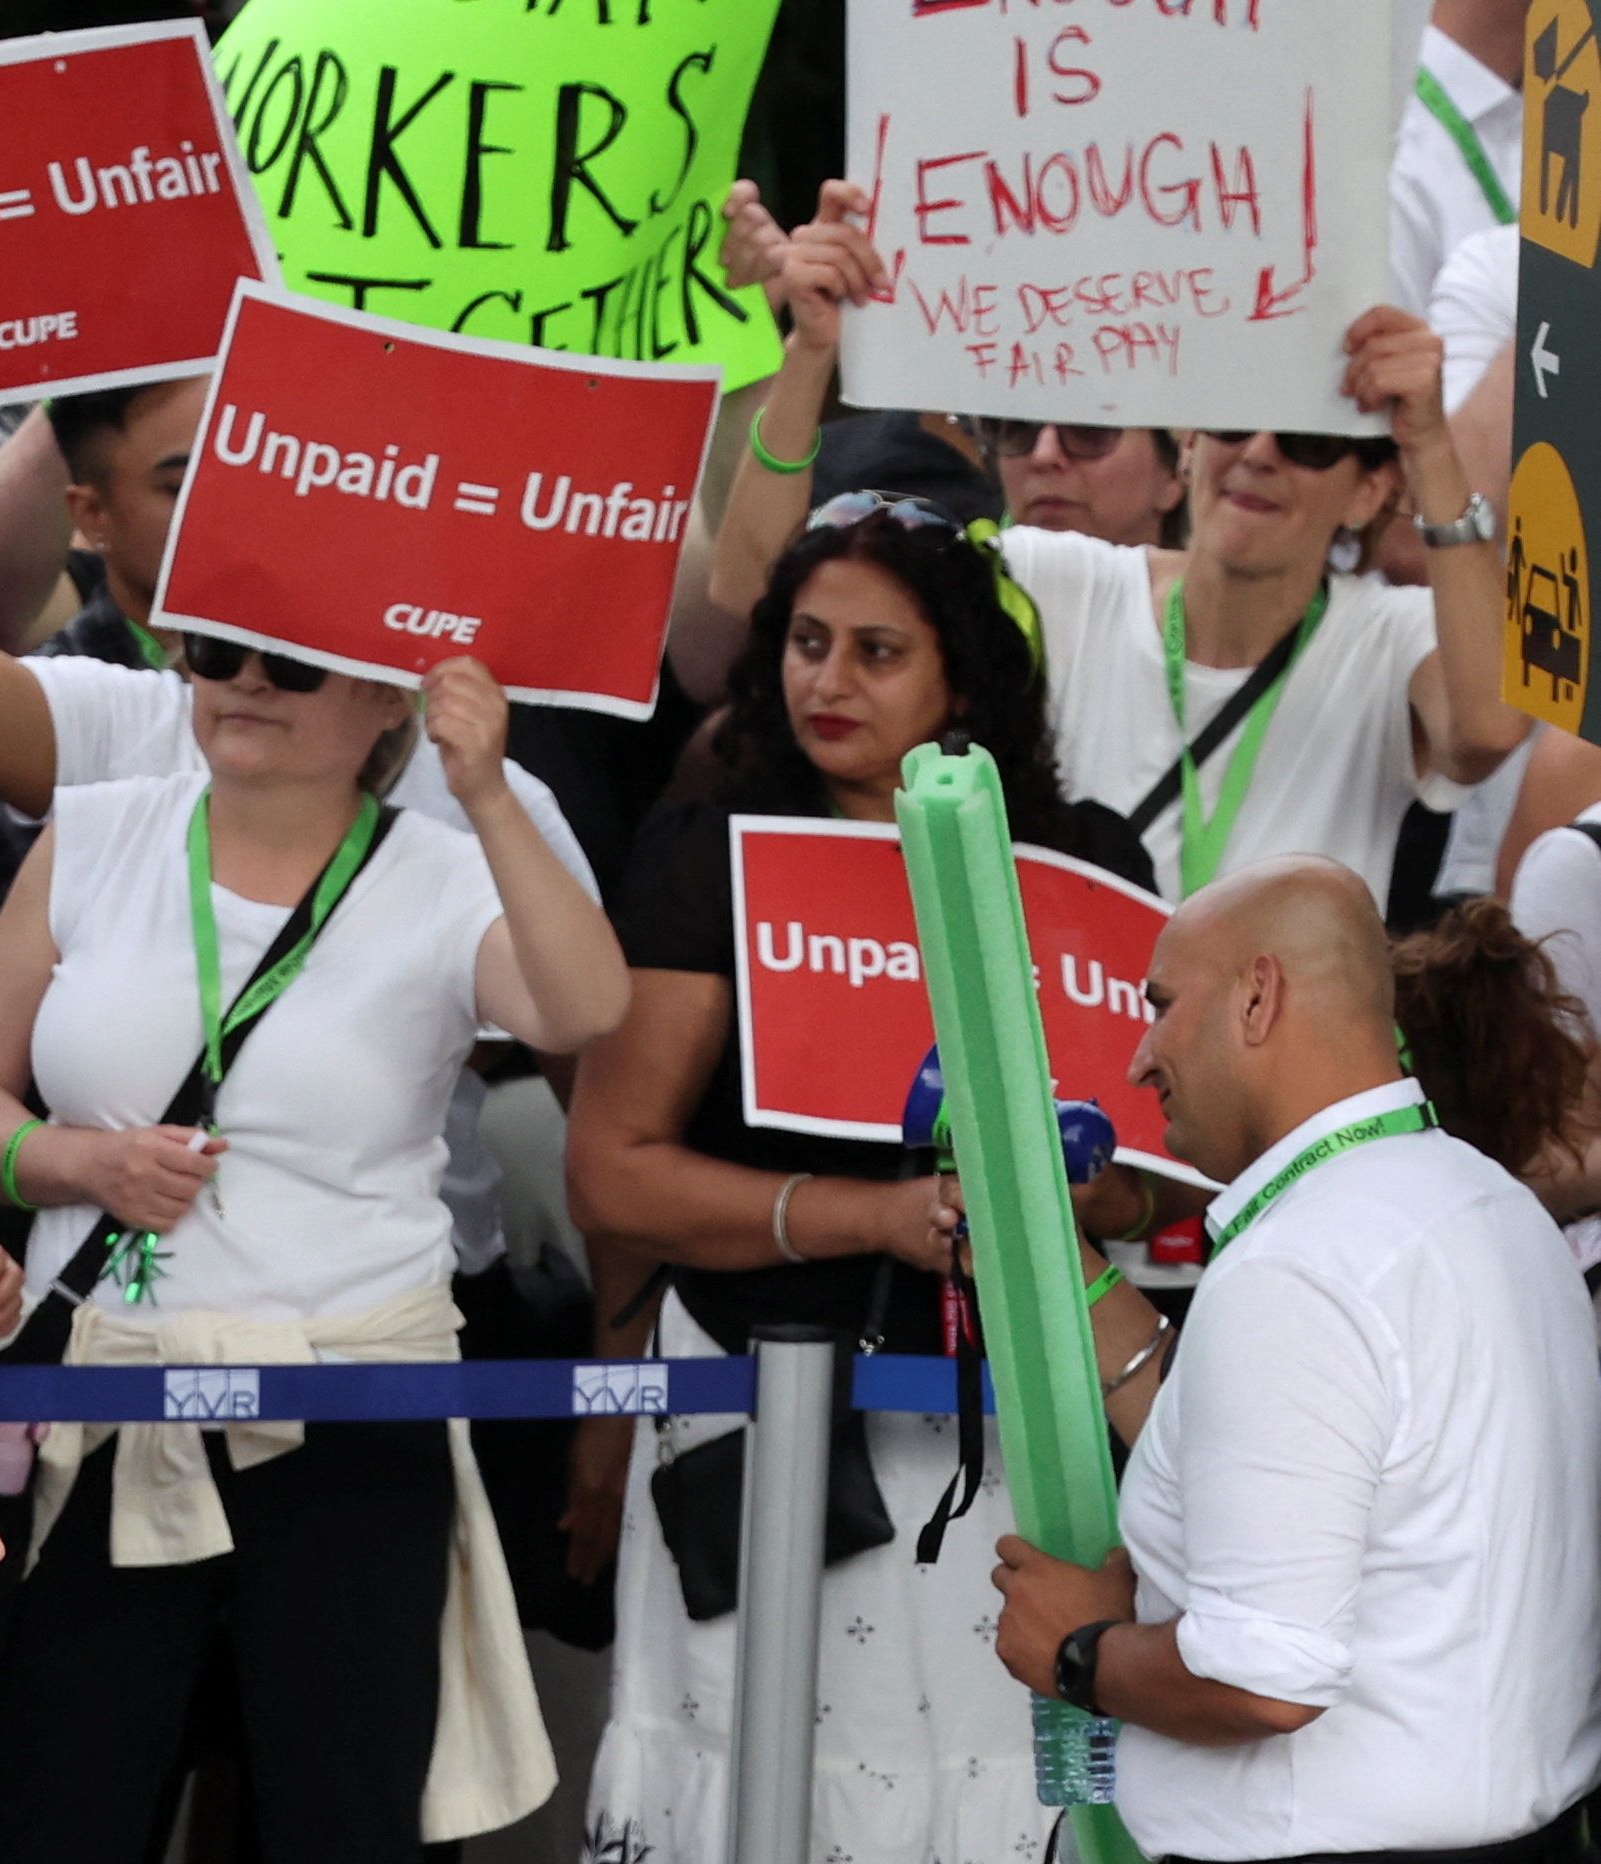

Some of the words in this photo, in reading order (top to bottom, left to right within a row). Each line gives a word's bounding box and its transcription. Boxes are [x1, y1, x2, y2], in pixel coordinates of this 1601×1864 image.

[1011, 24, 1102, 118] IS
[47, 140, 224, 218] Unfair
[913, 132, 1261, 246] ENOUGH
[907, 273, 1001, 337] WE
[1016, 267, 1231, 335] DESERVE
[964, 341, 1086, 389] FAIR
[1091, 321, 1181, 377] PAY
[211, 403, 440, 509] Unpaid
[519, 472, 688, 545] Unfair
[382, 602, 483, 646] CUPE
[755, 920, 921, 988] Unpa
[1231, 1196, 1261, 1235] Fair
[1261, 1139, 1334, 1202] Contract
[1335, 1117, 1386, 1149] Now!
